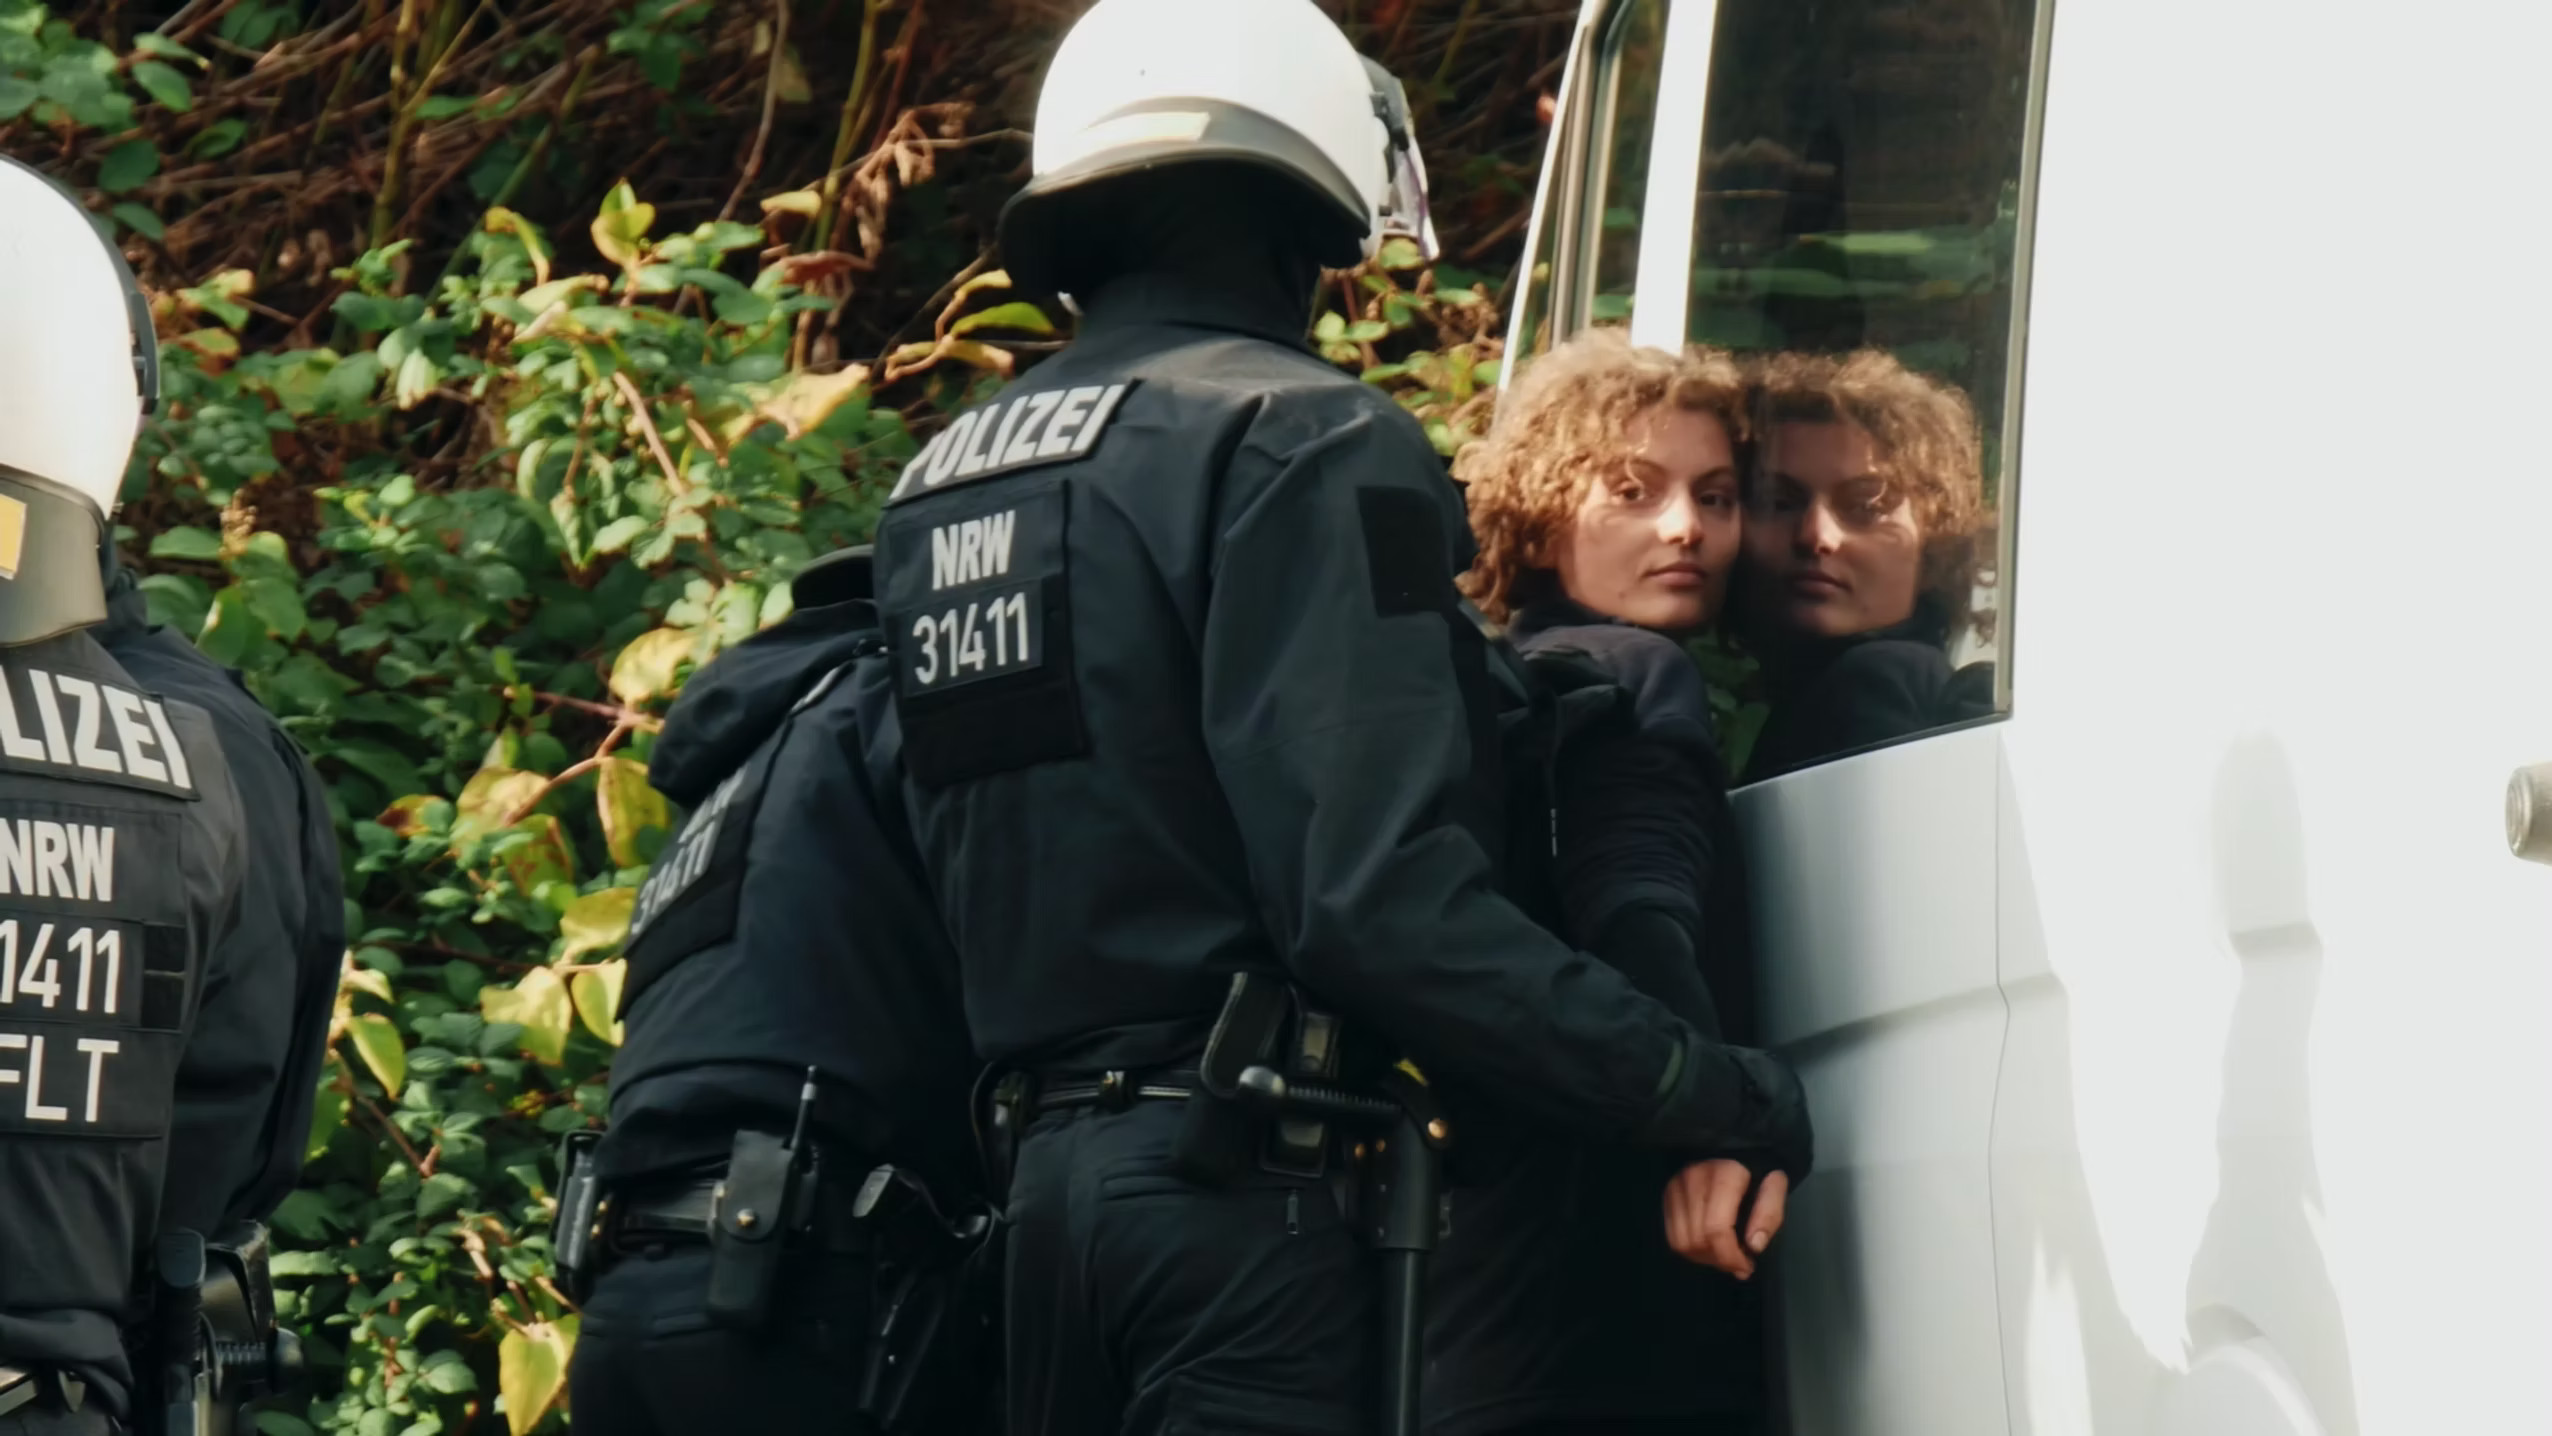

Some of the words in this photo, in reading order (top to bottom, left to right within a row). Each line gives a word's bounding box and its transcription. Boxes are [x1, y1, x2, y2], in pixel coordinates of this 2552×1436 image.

[932, 510, 1016, 590] NRW
[912, 592, 1029, 684] 31411
[0, 817, 115, 902] NRW
[0, 919, 120, 1014] 1411
